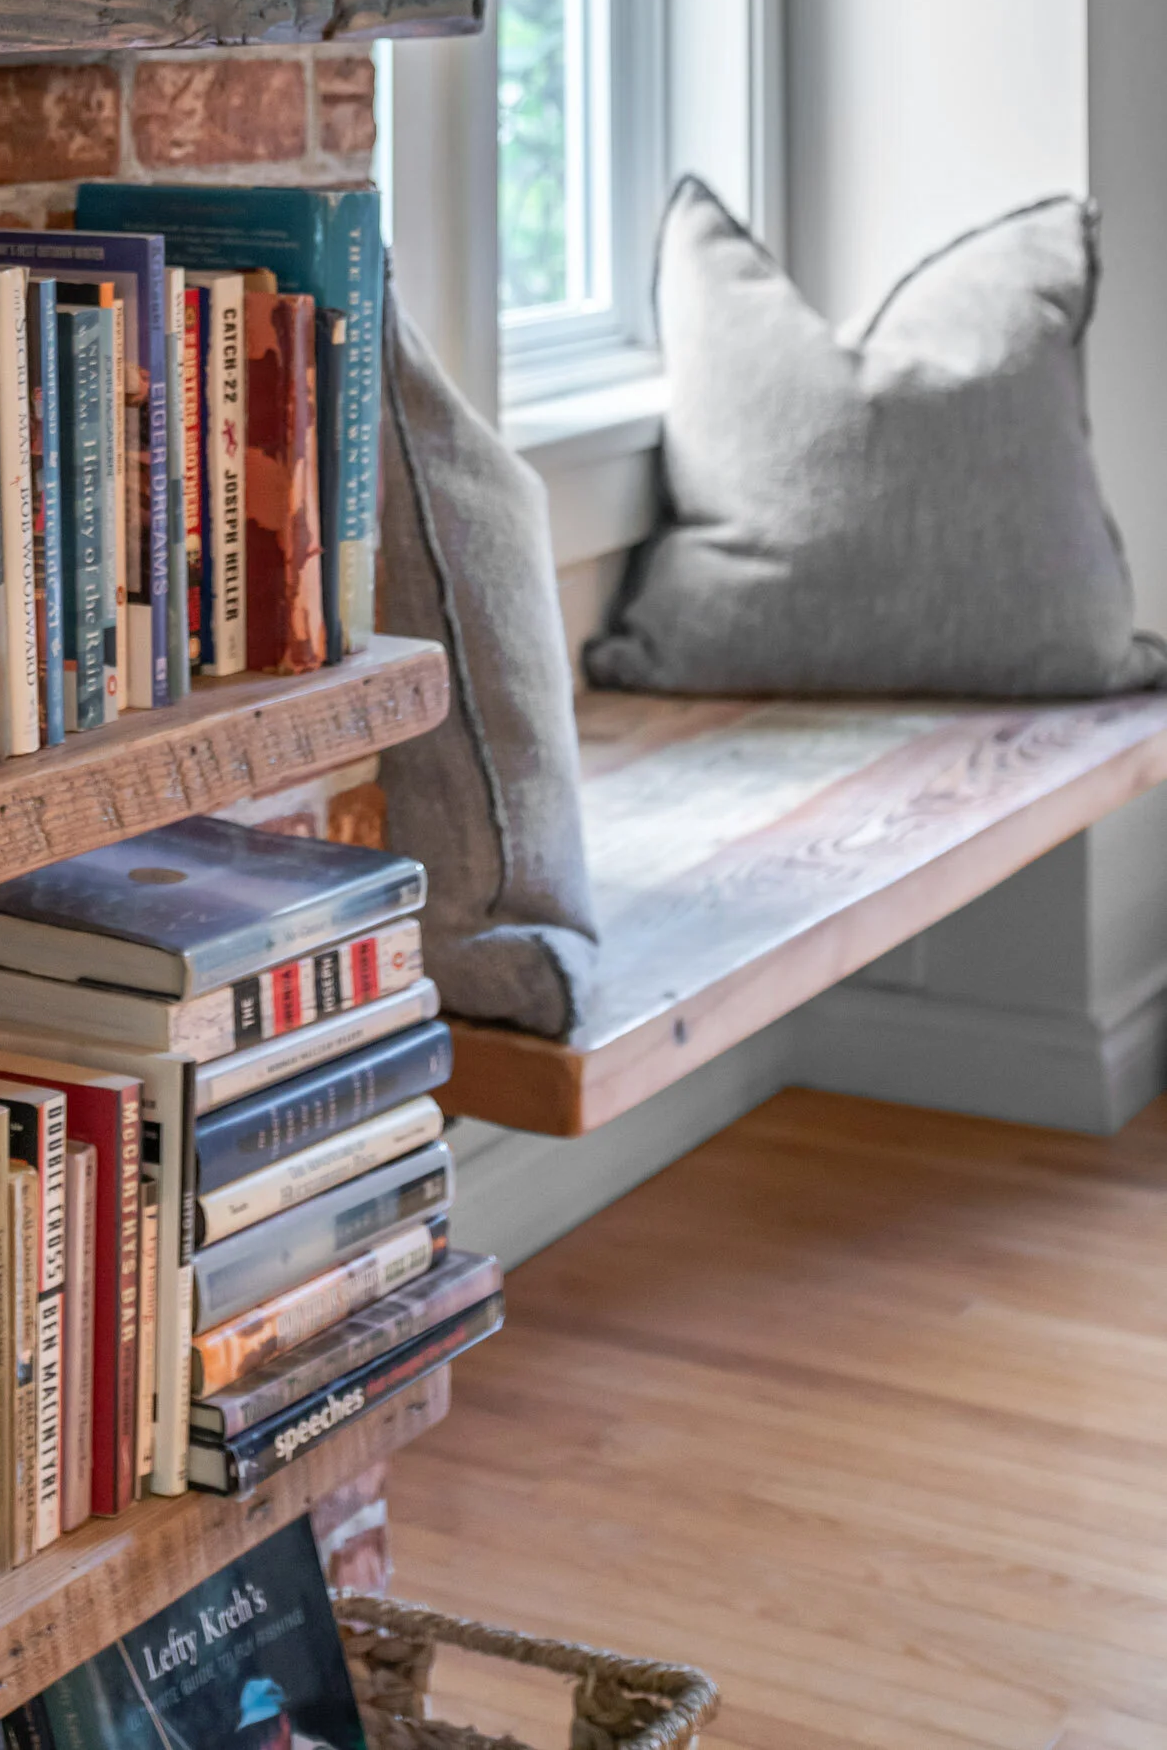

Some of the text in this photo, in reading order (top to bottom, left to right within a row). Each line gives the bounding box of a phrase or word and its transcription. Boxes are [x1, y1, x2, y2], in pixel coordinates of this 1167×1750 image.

[152, 381, 168, 597] EIGER DREAMS
[224, 308, 237, 622] CATCH-22 JOSEPH HELLER
[122, 1099, 137, 1343] McCARTHY'S BAR
[274, 1388, 366, 1459] speeches
[143, 1582, 268, 1681] Lefty Kreh's
